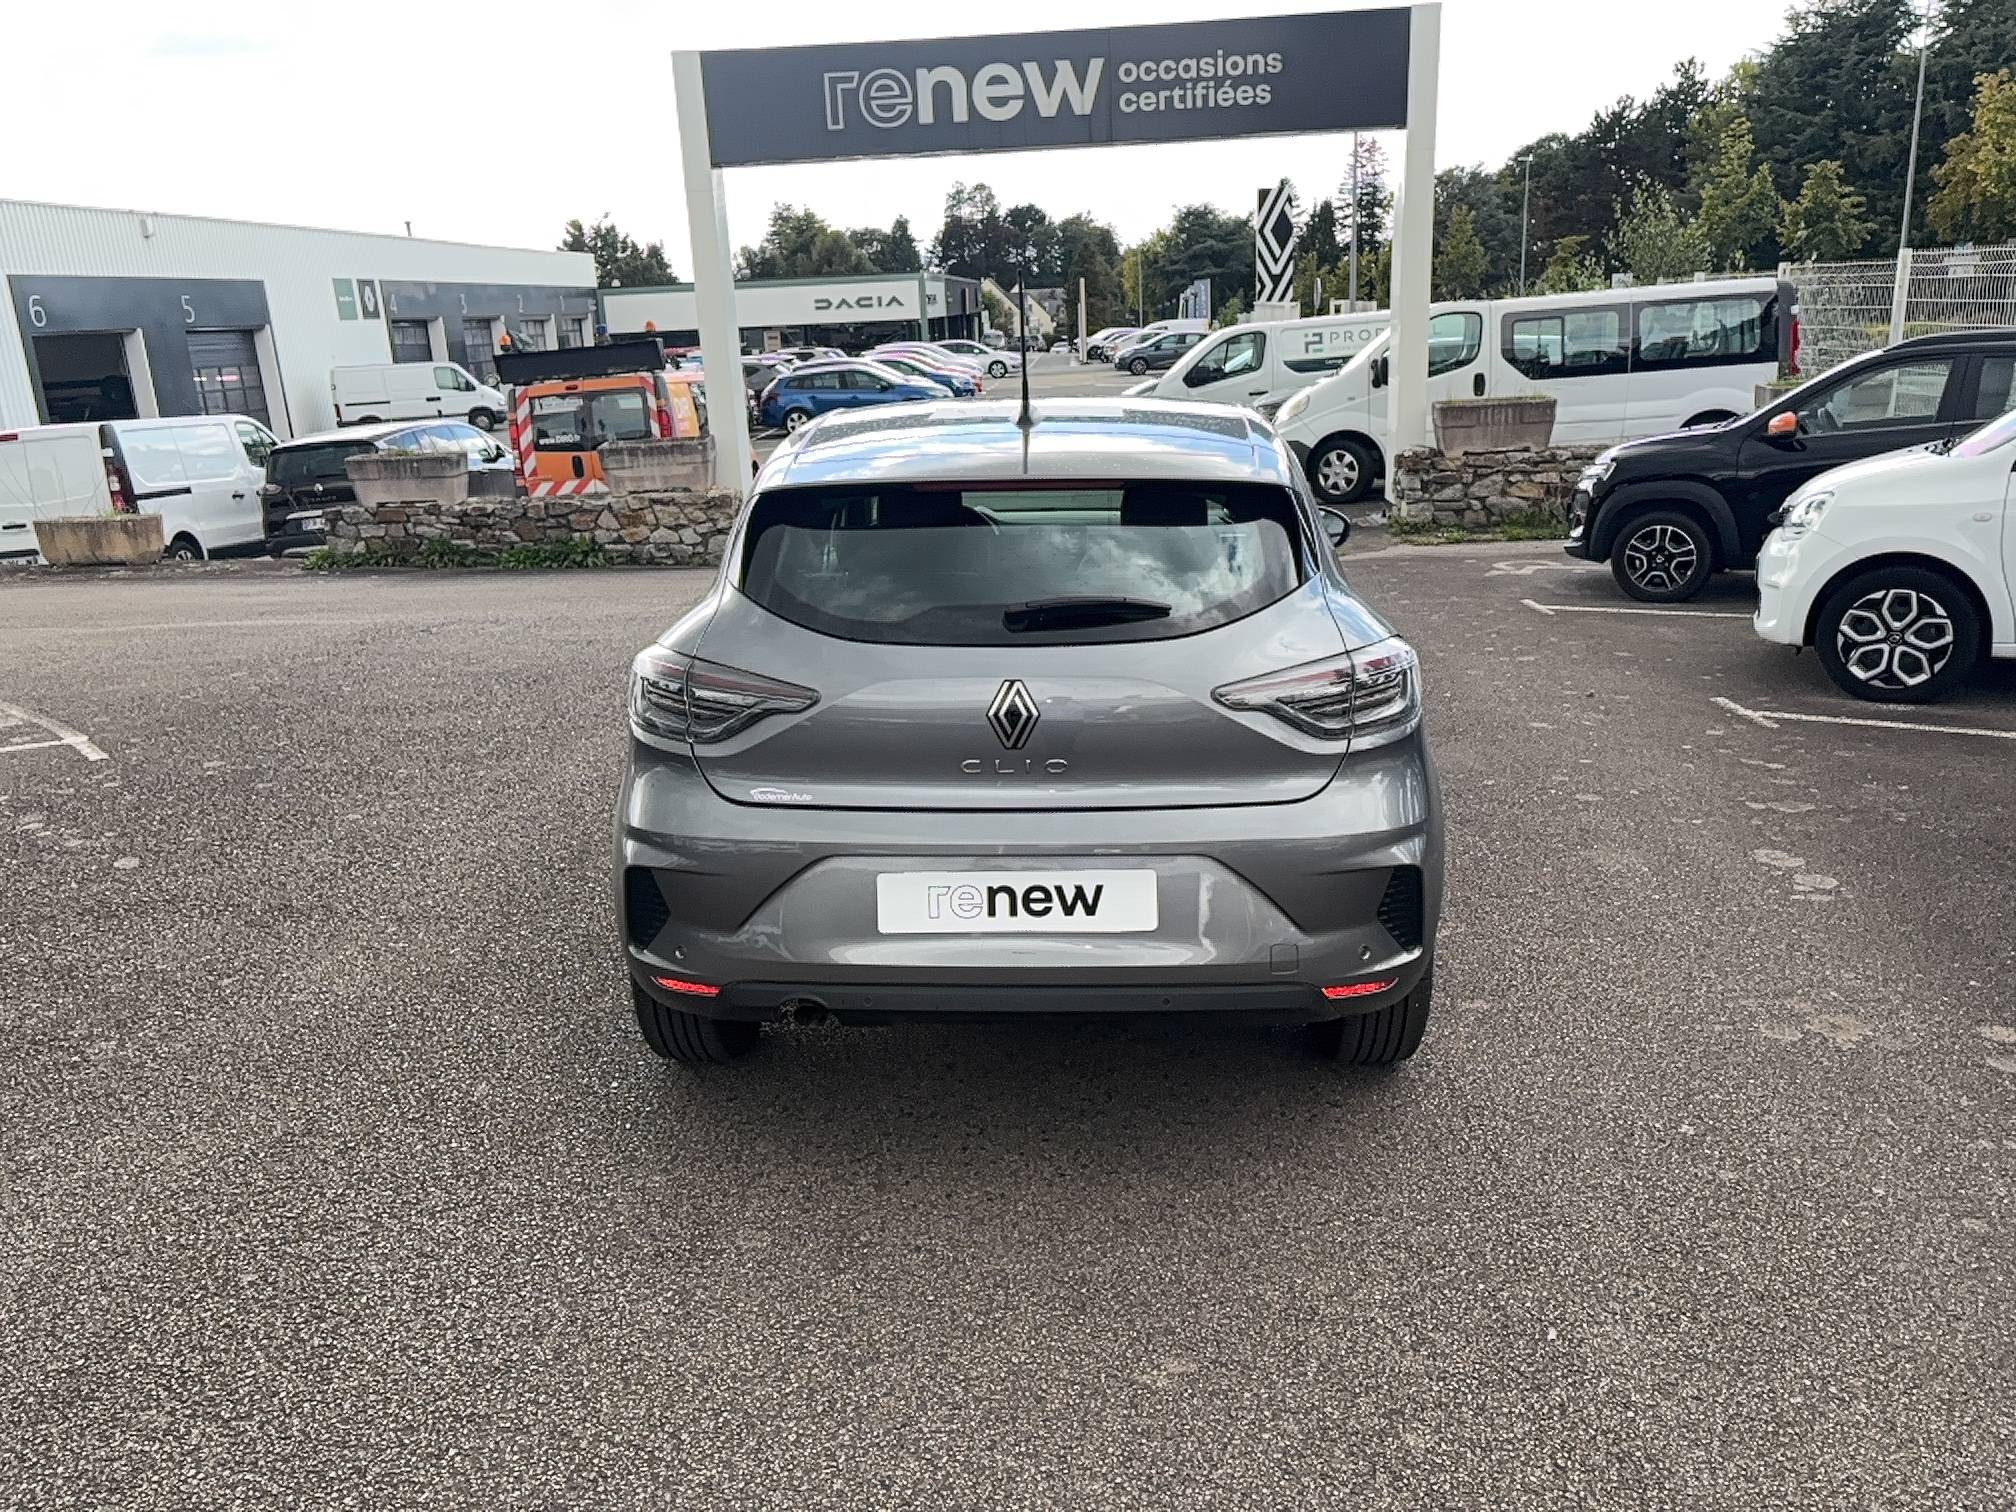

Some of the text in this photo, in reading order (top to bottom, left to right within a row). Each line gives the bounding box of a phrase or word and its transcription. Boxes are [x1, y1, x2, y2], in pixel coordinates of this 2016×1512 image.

[1117, 48, 1284, 84] occasions
[823, 57, 1105, 130] renew
[1118, 79, 1273, 113] certifiées
[28, 294, 48, 327] 6
[181, 295, 196, 323] 5
[814, 295, 904, 311] DACIA
[960, 758, 1069, 774] CLIO
[927, 884, 1103, 919] renew
